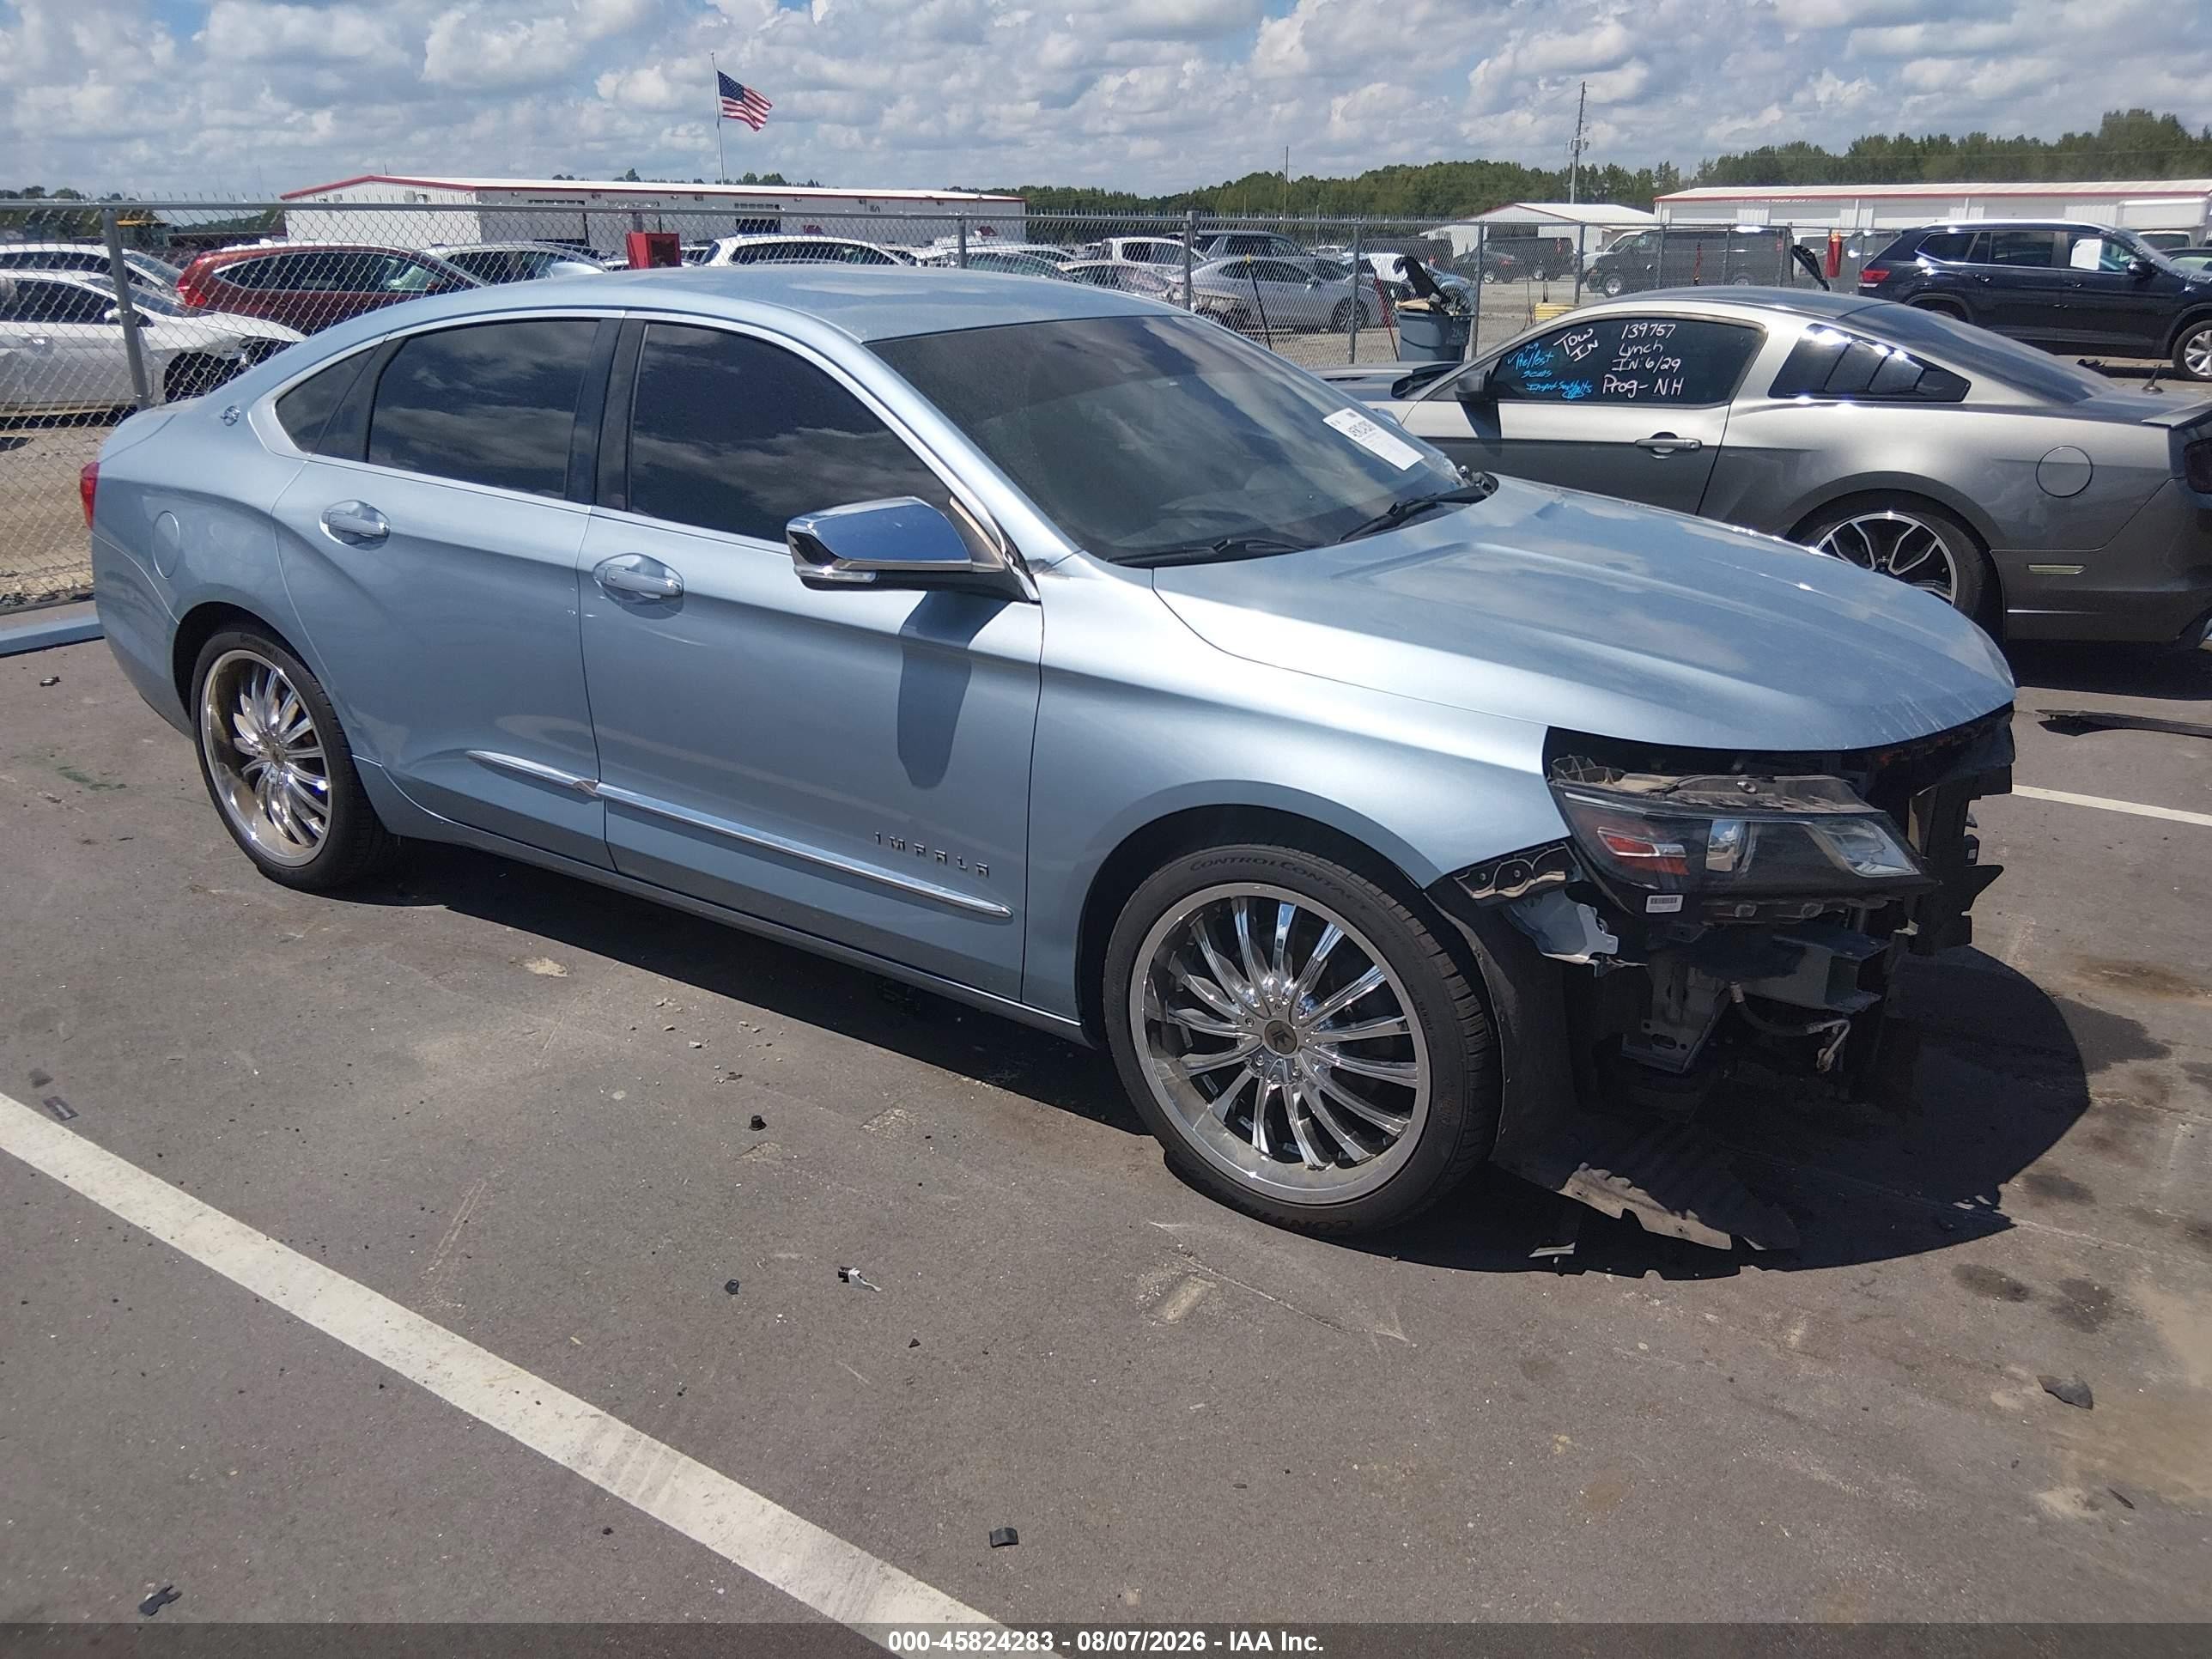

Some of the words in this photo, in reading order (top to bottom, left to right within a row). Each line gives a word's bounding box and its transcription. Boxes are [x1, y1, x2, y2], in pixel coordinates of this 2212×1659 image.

[1620, 323, 1675, 340] 139757
[1570, 339, 1600, 362] IN
[1619, 340, 1662, 360] Lynch
[1654, 378, 1685, 396] NH
[874, 831, 989, 878] IMPALA
